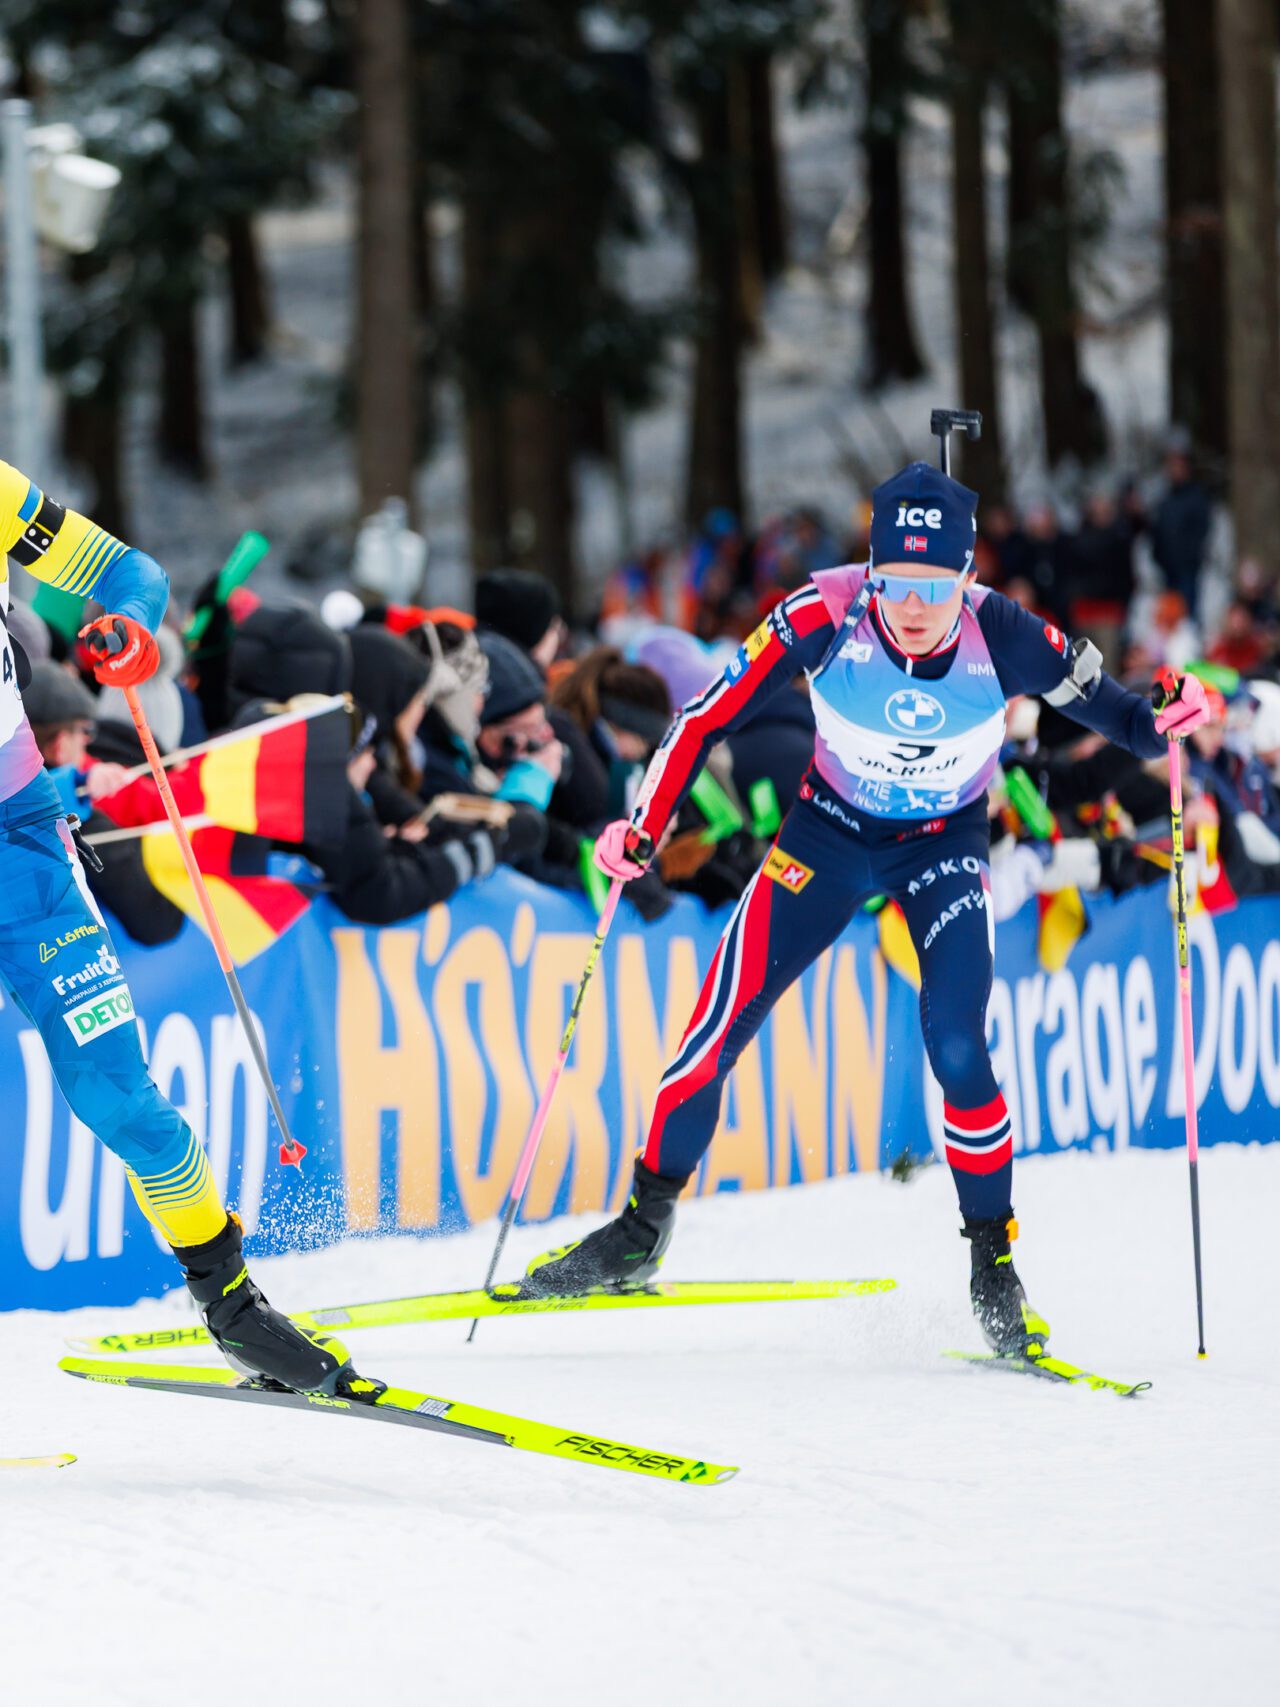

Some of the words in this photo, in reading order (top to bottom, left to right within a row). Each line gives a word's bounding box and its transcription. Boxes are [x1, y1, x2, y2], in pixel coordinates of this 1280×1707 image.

[895, 501, 942, 530] ice
[3, 646, 13, 684] 4
[858, 779, 891, 801] THE
[56, 925, 99, 947] Löffler
[924, 954, 1158, 1160] arage
[308, 1396, 352, 1410] FISCHER
[555, 1435, 686, 1474] FISCHER
